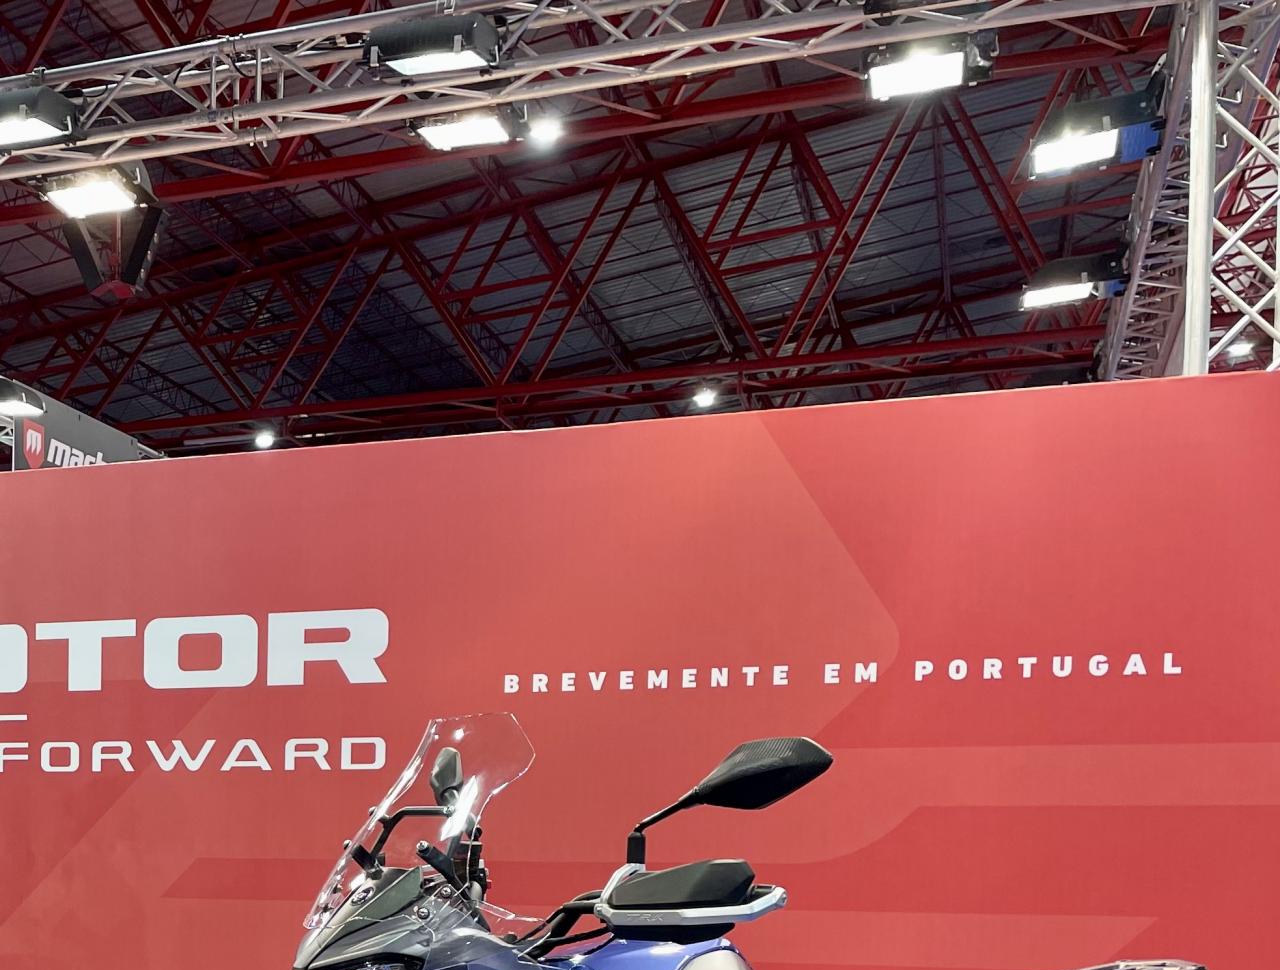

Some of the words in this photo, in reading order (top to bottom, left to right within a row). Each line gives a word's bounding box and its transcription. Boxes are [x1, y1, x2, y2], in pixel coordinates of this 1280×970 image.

[503, 665, 789, 694] BREVEMENTE
[824, 662, 878, 684] EM
[914, 652, 1183, 682] PORTUGAL
